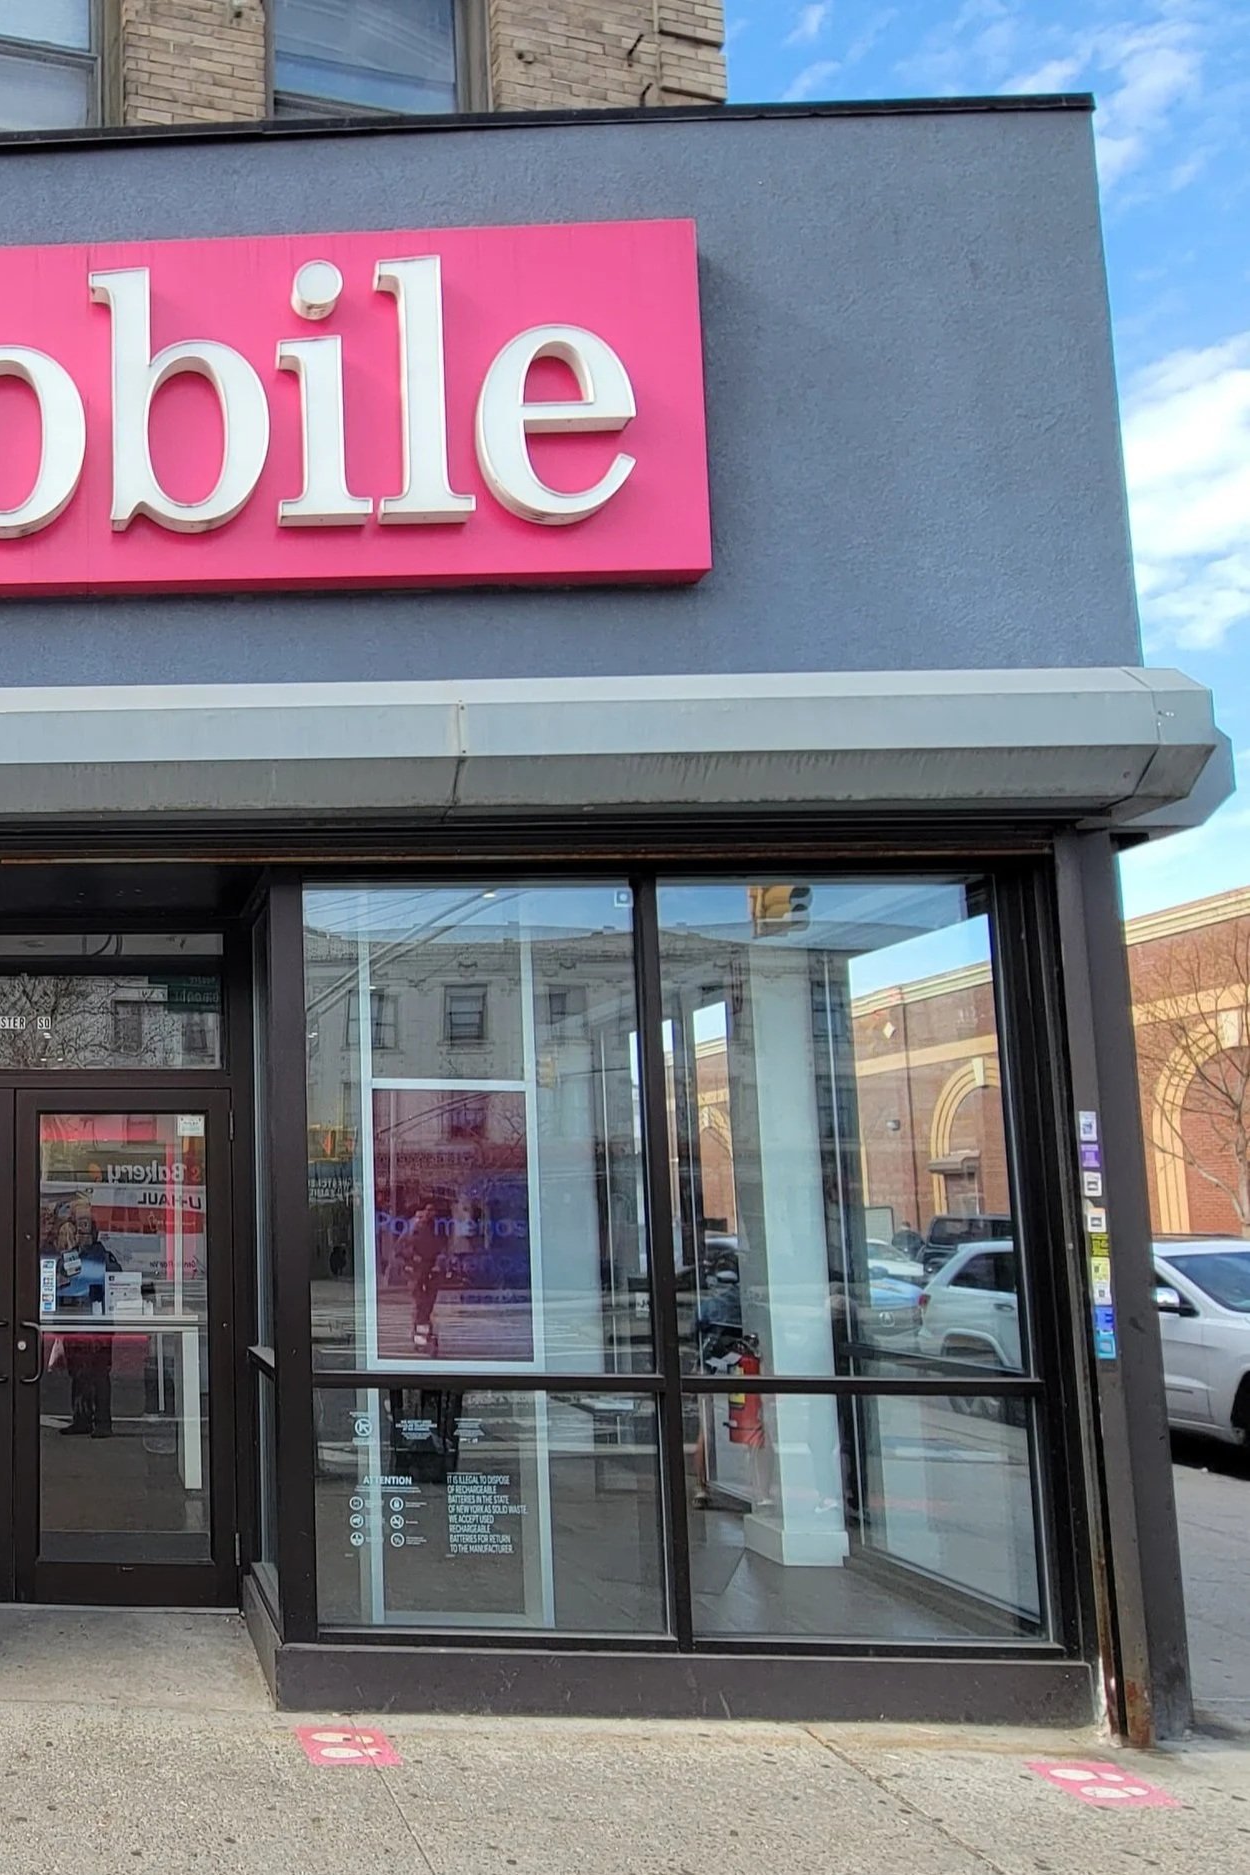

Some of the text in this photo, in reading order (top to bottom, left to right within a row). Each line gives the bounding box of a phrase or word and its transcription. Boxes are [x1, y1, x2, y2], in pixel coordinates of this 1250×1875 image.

[458, 1475, 479, 1484] ILLEGAL
[479, 1475, 487, 1484] TO
[487, 1475, 510, 1485] DISPOSE
[447, 1485, 497, 1494] OF RECHARGEABLE
[447, 1495, 509, 1504] BATTERIES IN THE STATE
[448, 1504, 528, 1514] OF NEW YORK AS SOLID WASTE.
[449, 1514, 495, 1524] WE ACCEPT USED
[449, 1524, 491, 1533] RECHARGEABLE
[449, 1534, 511, 1543] BATTERIES FOR RETURN
[450, 1544, 514, 1554] TO THE MANUFACTURER.
